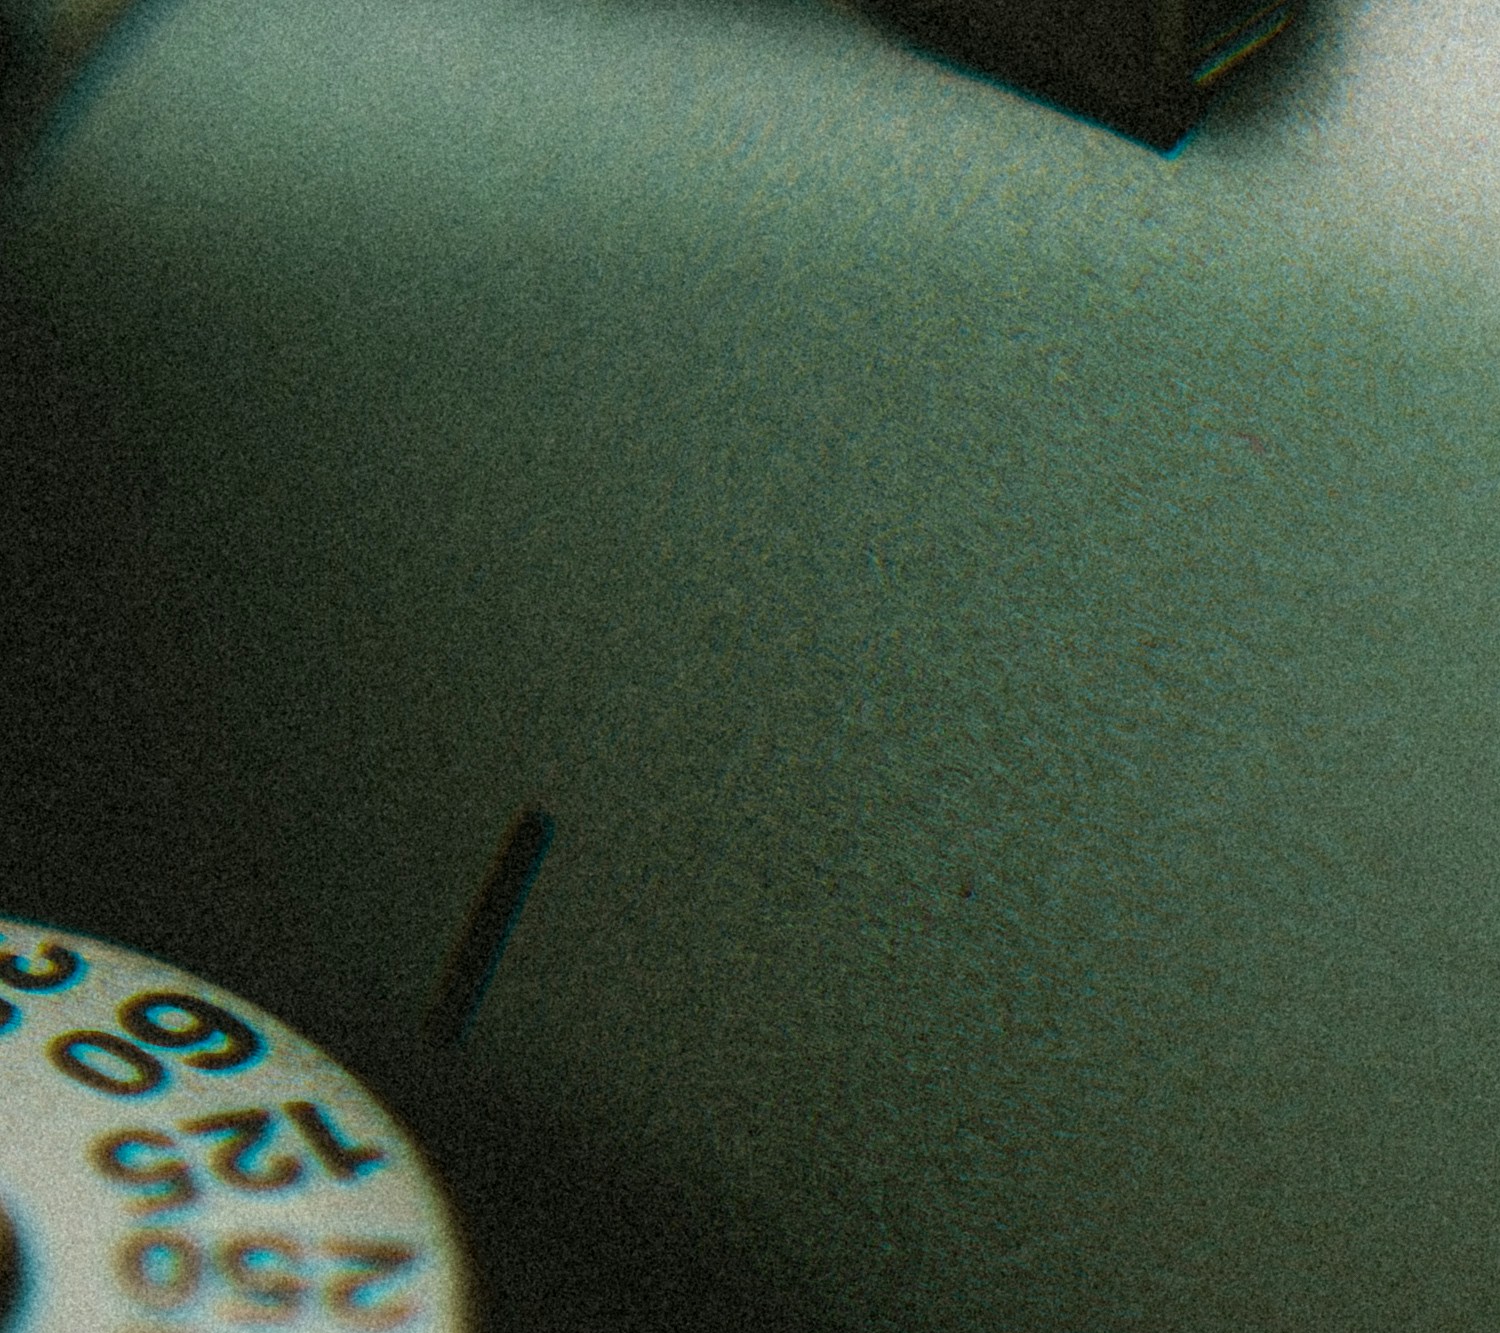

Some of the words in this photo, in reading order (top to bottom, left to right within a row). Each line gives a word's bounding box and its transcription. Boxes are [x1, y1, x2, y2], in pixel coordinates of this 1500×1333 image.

[46, 990, 268, 1100] 60
[86, 1100, 384, 1216] 125
[114, 1222, 422, 1333] 250
